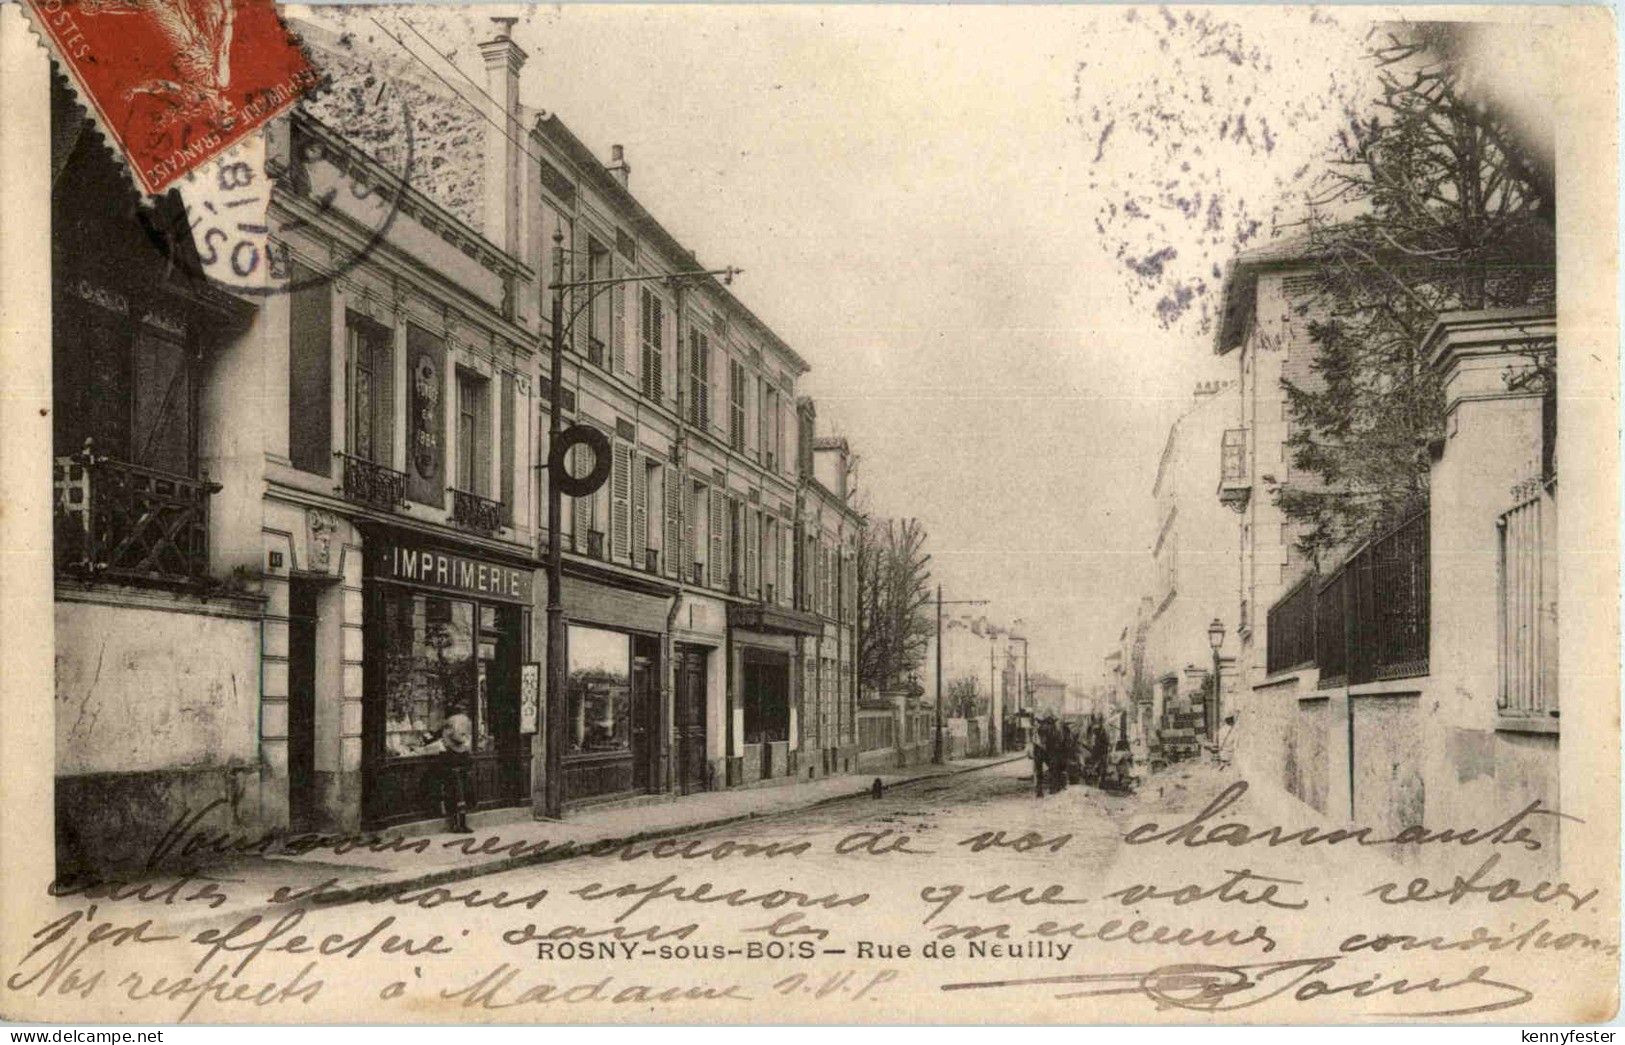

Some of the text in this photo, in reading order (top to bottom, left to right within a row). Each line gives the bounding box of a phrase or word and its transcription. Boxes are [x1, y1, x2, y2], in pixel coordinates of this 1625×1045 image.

[44, 0, 90, 58] OSTES
[394, 547, 519, 596] IMPRIMERIE
[443, 834, 813, 862] remercions
[835, 828, 935, 855] de
[957, 830, 1074, 853] vos
[267, 878, 339, 903] et
[368, 888, 549, 910] nous
[919, 884, 1088, 925] que
[1103, 868, 1309, 910] votre
[502, 920, 700, 946] dans
[740, 913, 830, 940] les
[536, 941, 816, 961] ROSNY-sous-BOIS
[856, 940, 912, 960] Rue
[922, 940, 957, 960] de
[968, 940, 1074, 962] Neuilly
[6, 936, 105, 998] Nos
[117, 960, 325, 1023] respects
[379, 966, 423, 1001] à
[439, 962, 754, 1010] Madame
